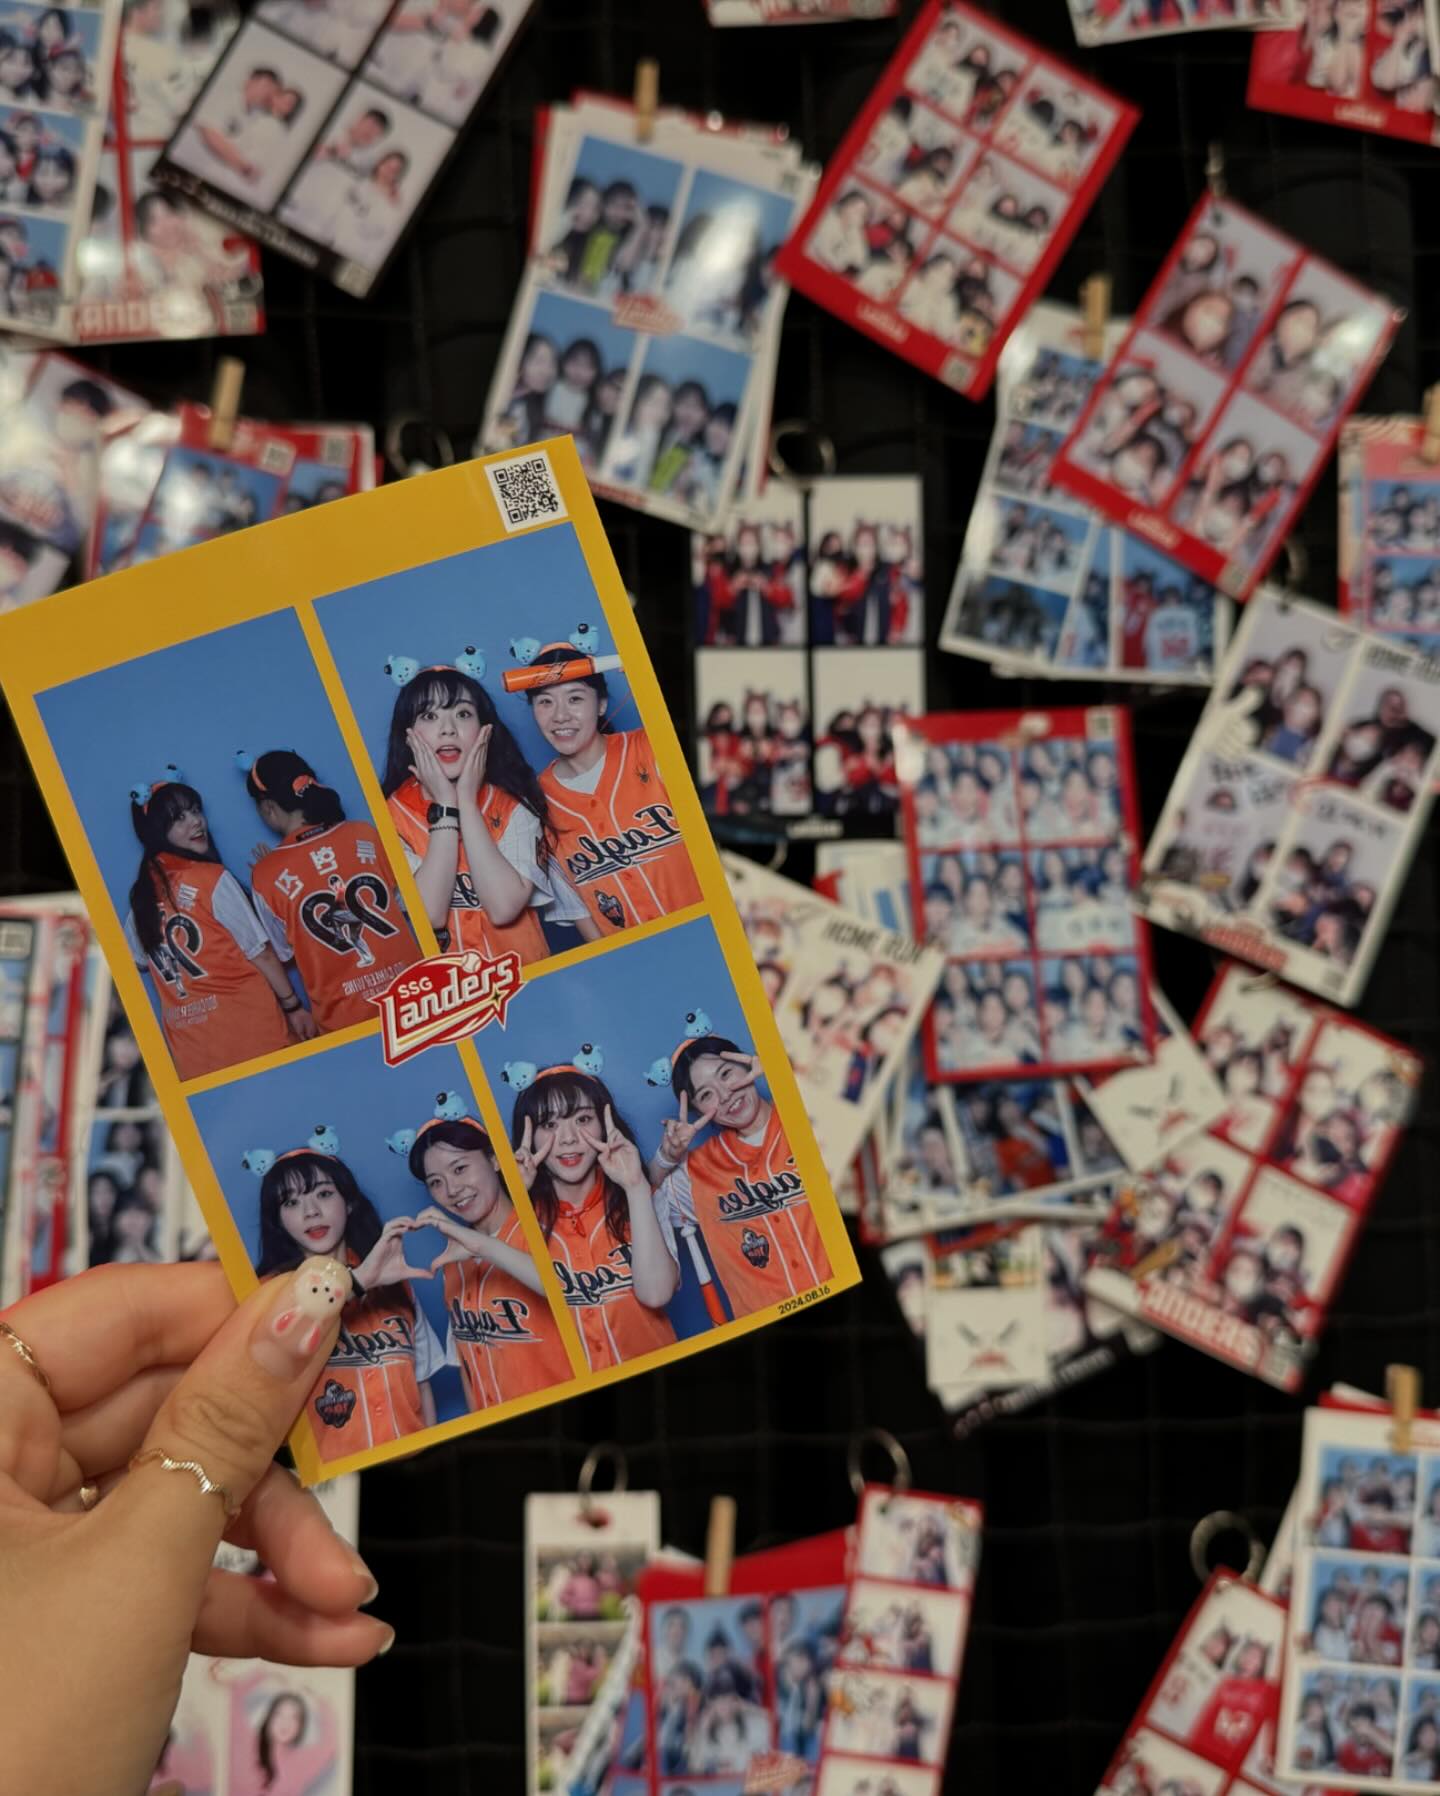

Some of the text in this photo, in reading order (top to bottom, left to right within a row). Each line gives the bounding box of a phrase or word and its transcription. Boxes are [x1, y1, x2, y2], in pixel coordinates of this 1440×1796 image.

[397, 976, 434, 999] SSG
[384, 957, 515, 1061] Landers
[777, 1284, 832, 1316] 2024.08.16
